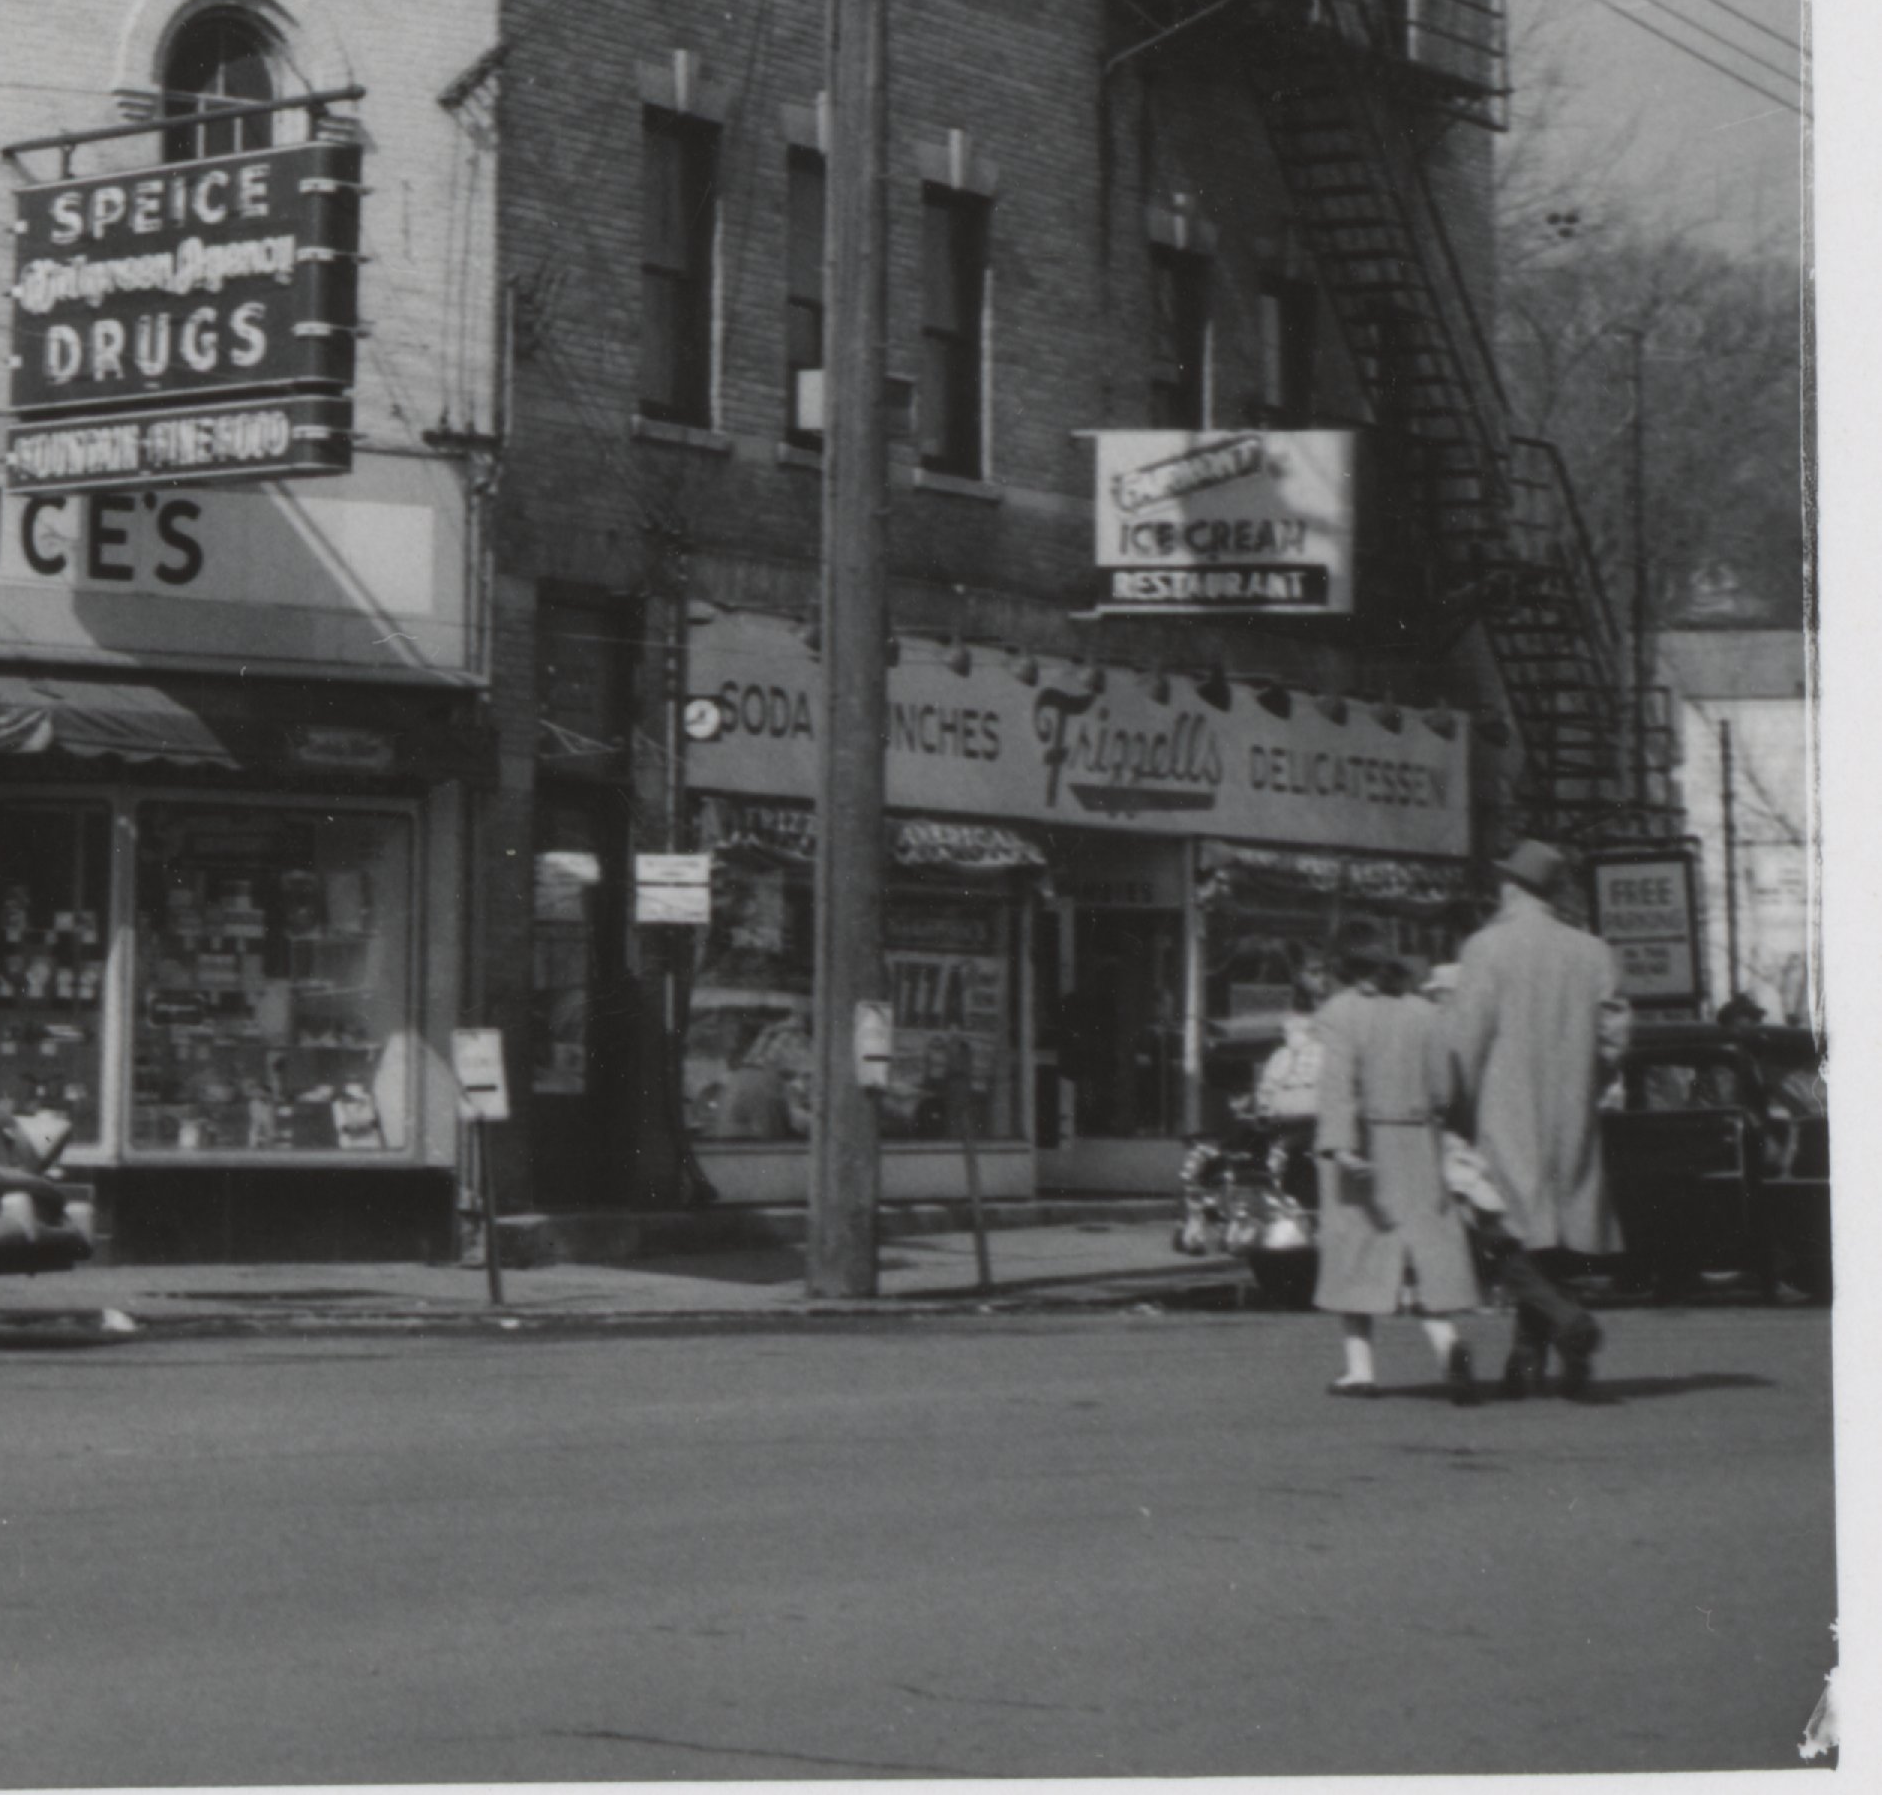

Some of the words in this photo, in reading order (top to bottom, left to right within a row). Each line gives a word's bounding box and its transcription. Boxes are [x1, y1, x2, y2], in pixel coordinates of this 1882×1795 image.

[49, 163, 272, 245] SPEICE
[44, 301, 268, 385] DRUGS
[1120, 520, 1174, 555] ICE
[1183, 518, 1306, 555] CREAM
[1112, 571, 1307, 599] RESTAURANT
[720, 679, 815, 741] SODA
[889, 703, 1001, 762] NCHES
[1250, 743, 1448, 810] DELICATESSEN
[1608, 876, 1673, 907] FREE
